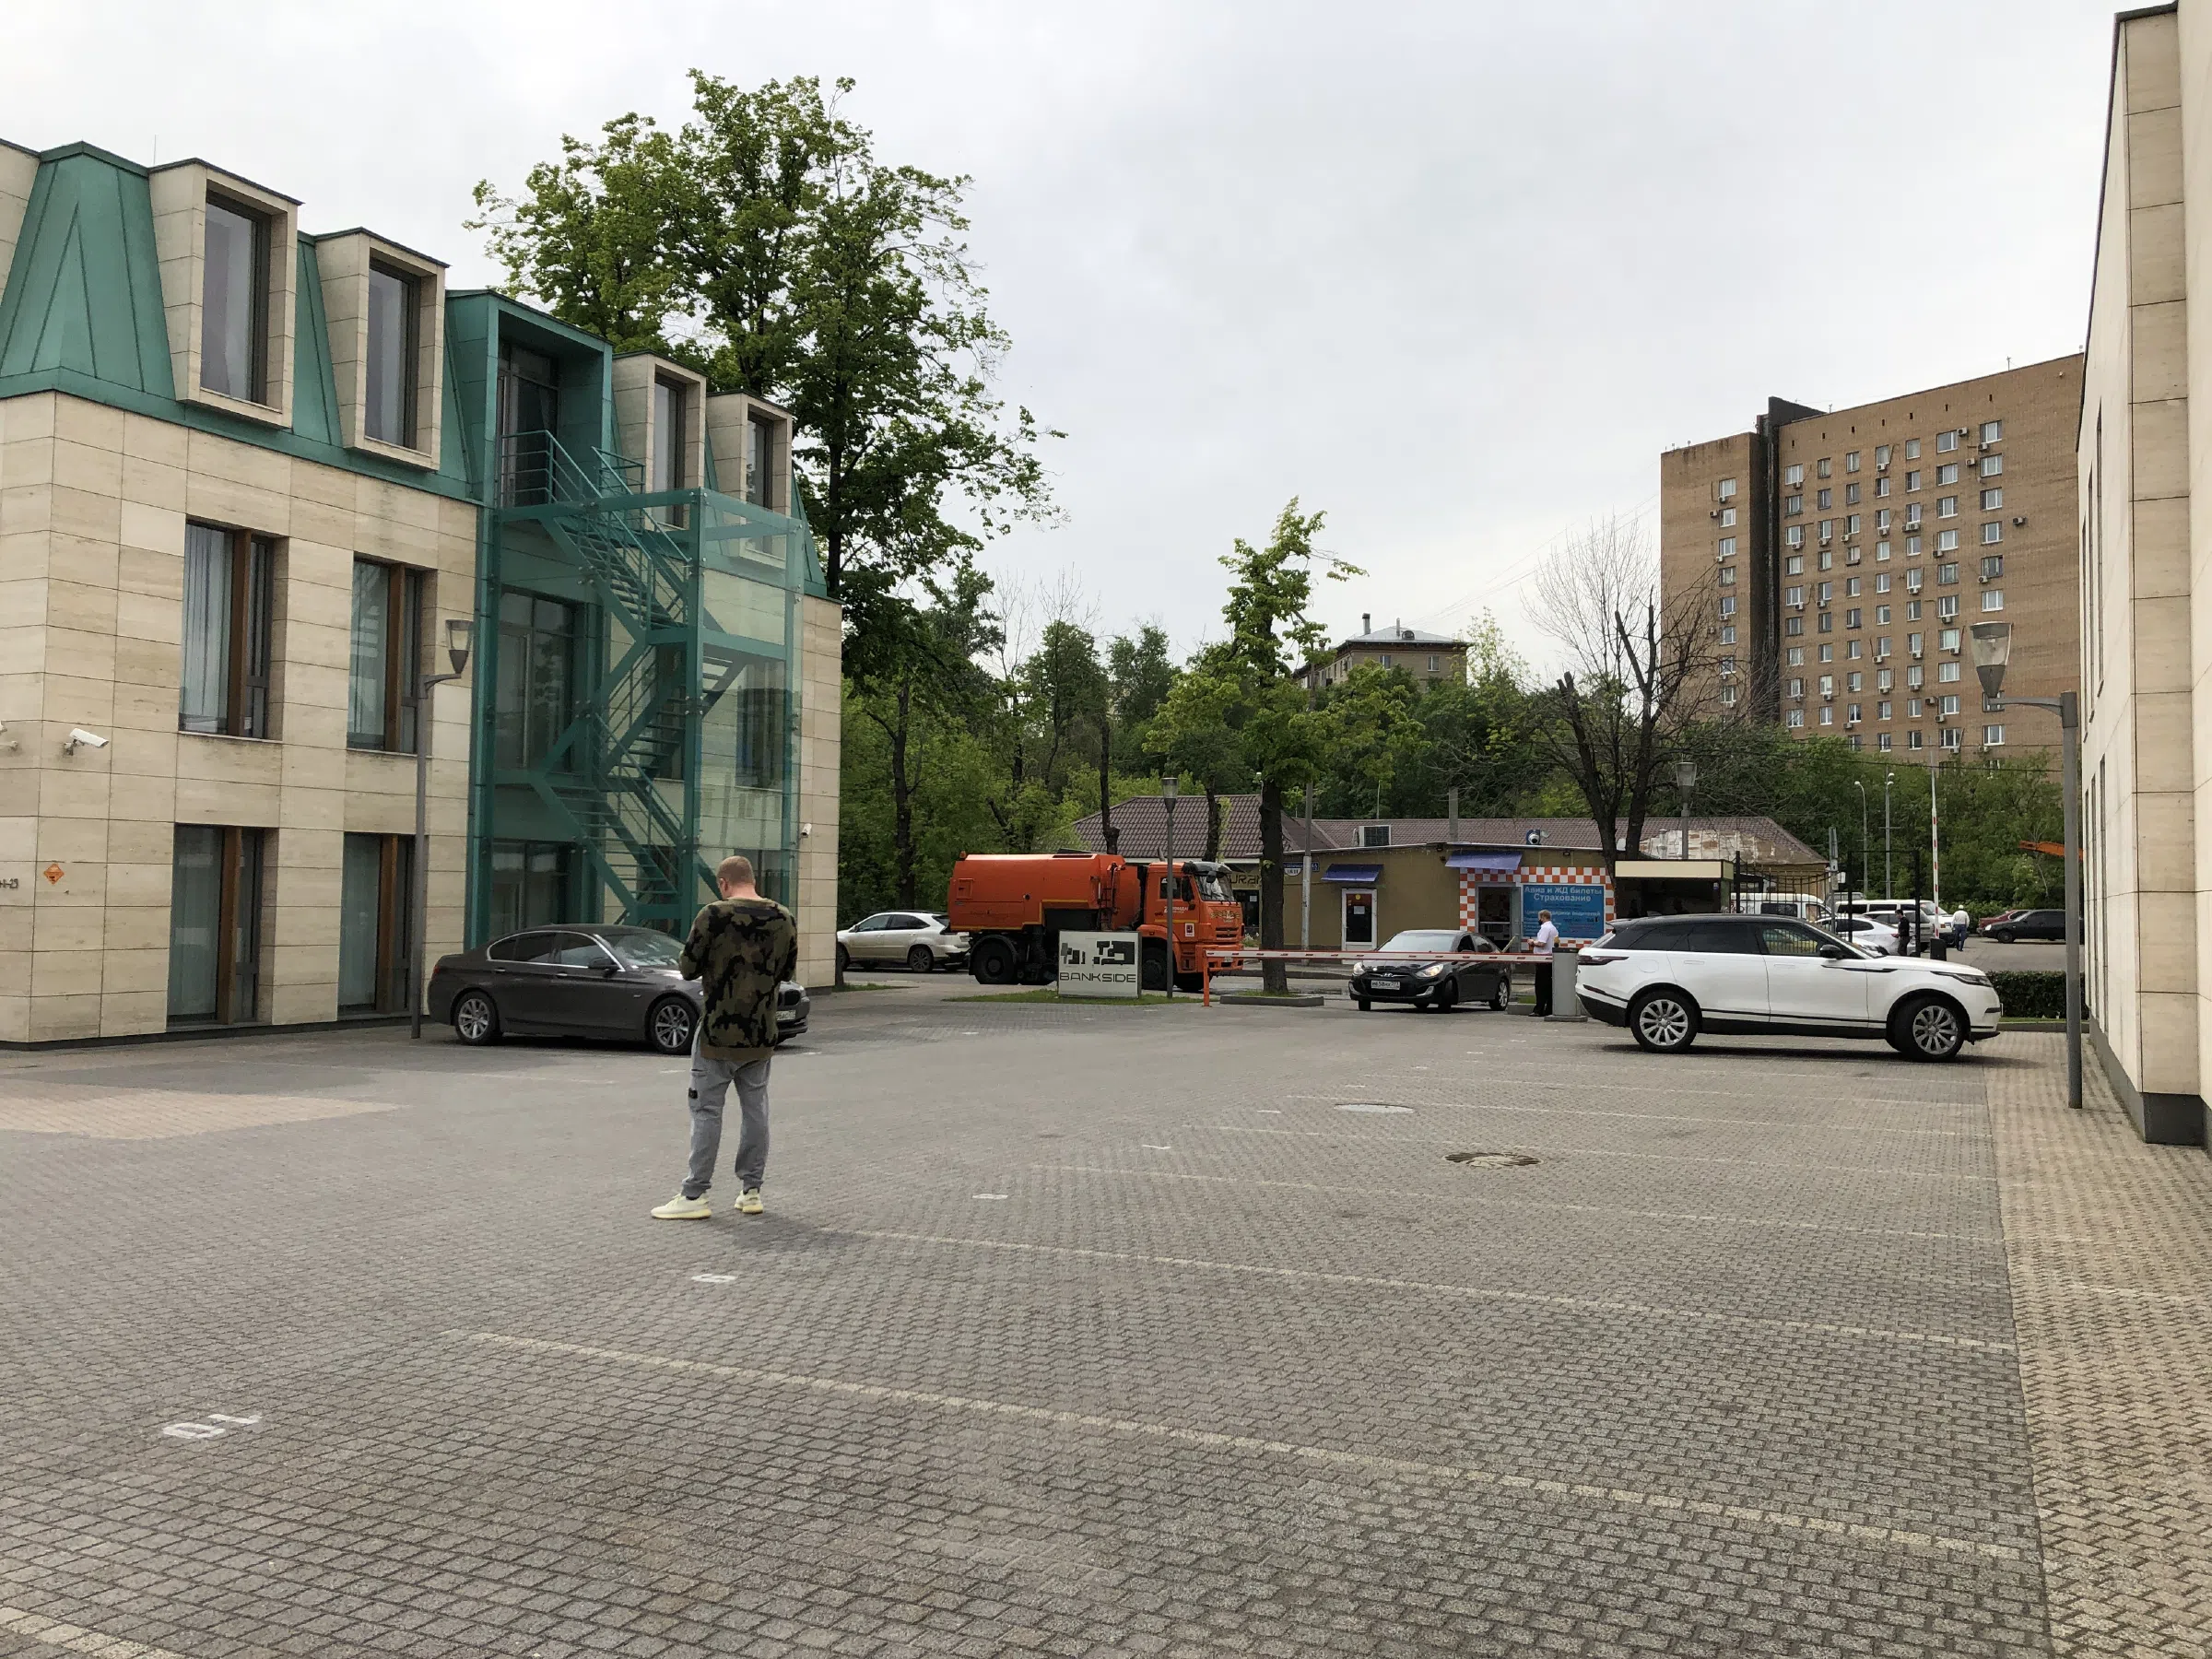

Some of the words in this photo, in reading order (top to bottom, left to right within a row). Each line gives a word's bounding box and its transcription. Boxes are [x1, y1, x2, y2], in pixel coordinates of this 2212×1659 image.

[1555, 887, 1568, 895] ЖД
[1571, 887, 1602, 895] билеты
[1534, 893, 1592, 902] Страхование
[1060, 972, 1136, 983] BANKSIDE
